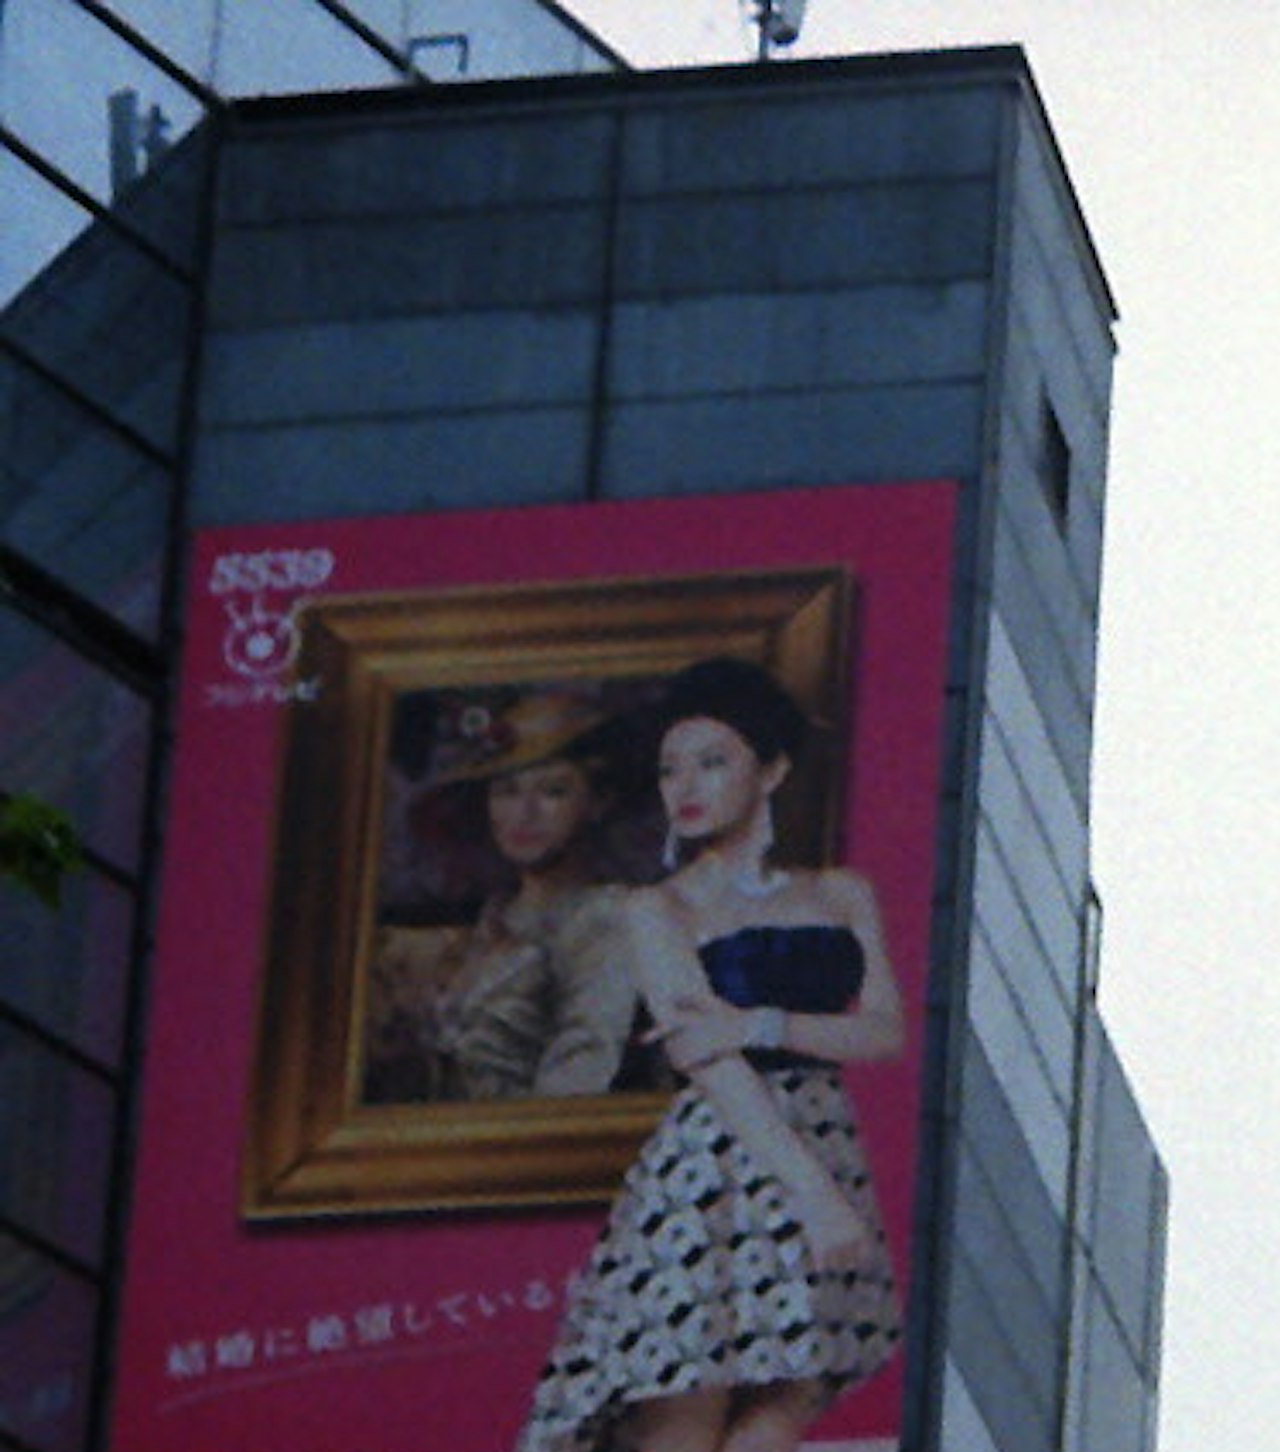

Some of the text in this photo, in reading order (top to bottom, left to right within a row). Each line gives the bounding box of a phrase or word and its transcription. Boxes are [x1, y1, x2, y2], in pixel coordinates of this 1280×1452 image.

[166, 1277, 582, 1378] 結婚に絶望している
